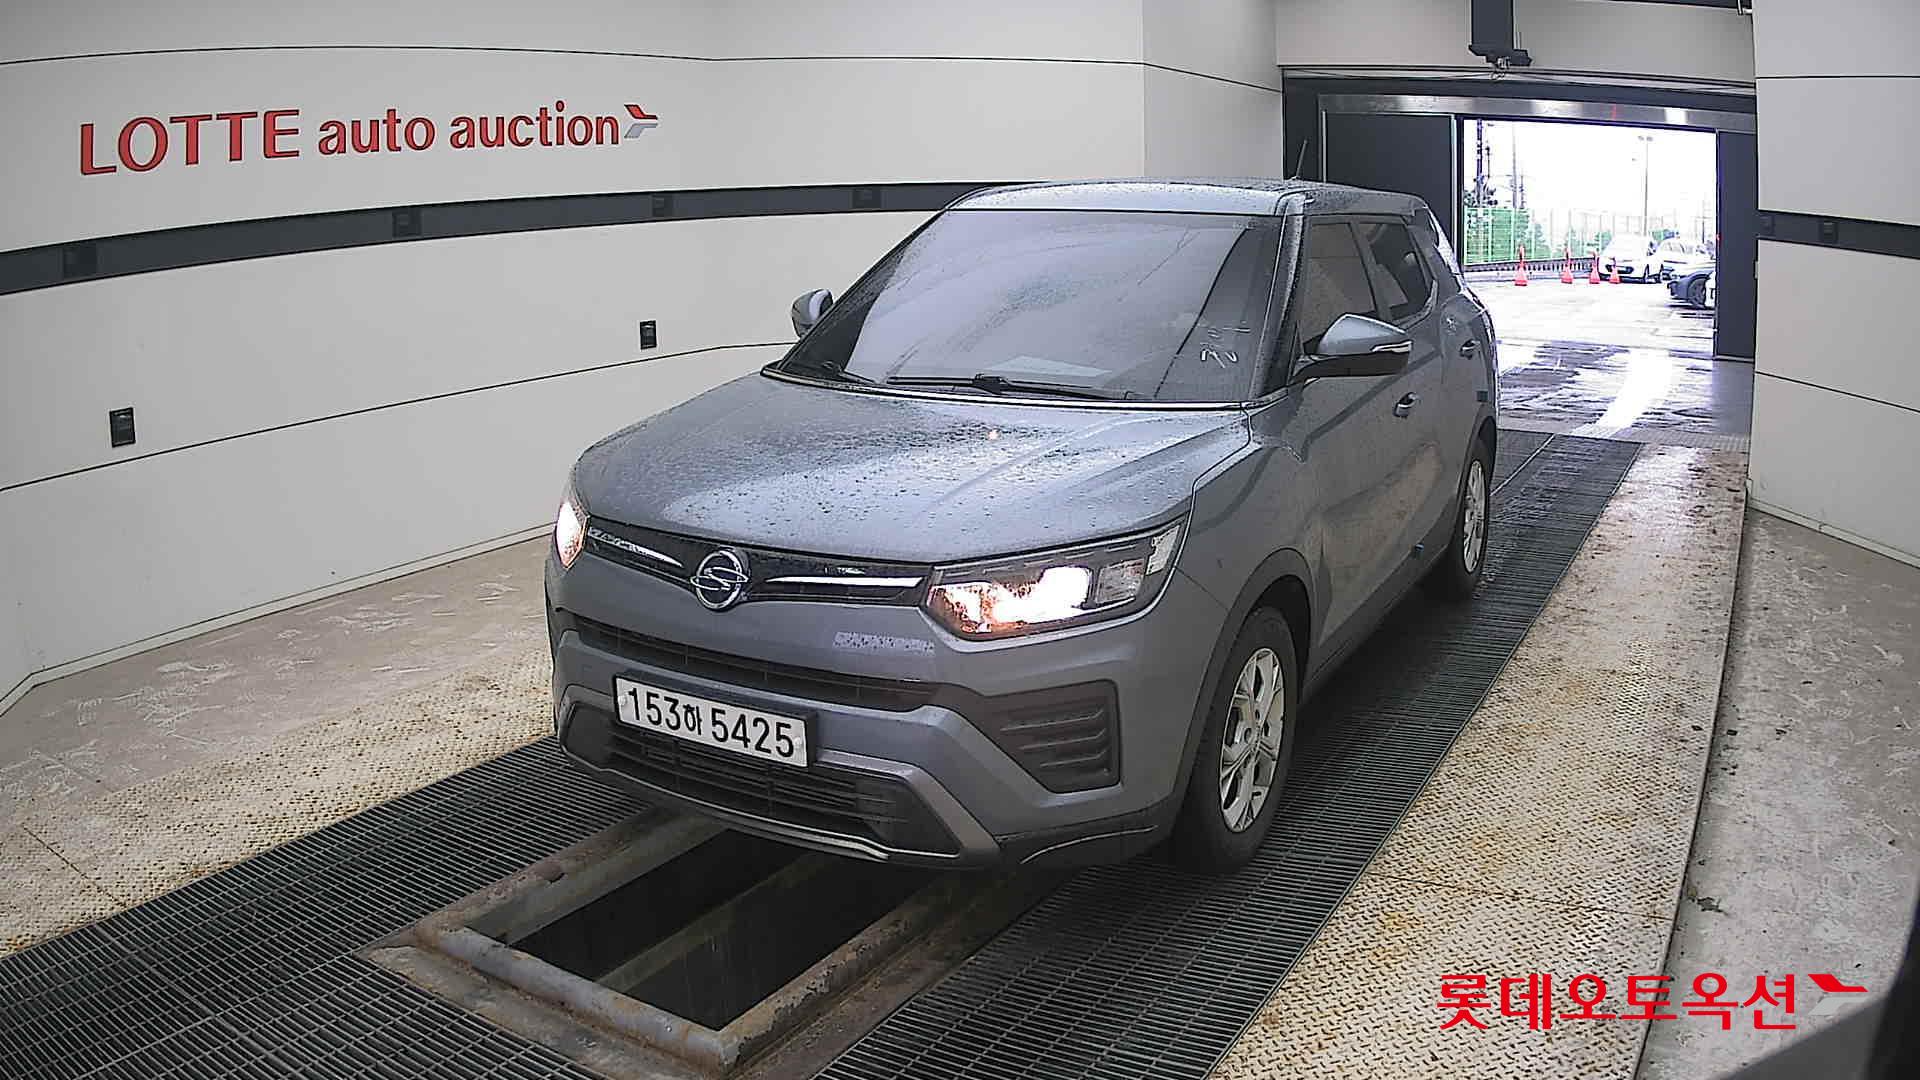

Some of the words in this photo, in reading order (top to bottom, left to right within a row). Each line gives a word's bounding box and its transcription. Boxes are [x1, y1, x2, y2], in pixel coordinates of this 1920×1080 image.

[80, 109, 300, 175] LOTTE
[317, 108, 436, 156] auto
[449, 100, 620, 150] auction
[628, 688, 703, 736] 153하
[711, 708, 794, 758] 5425
